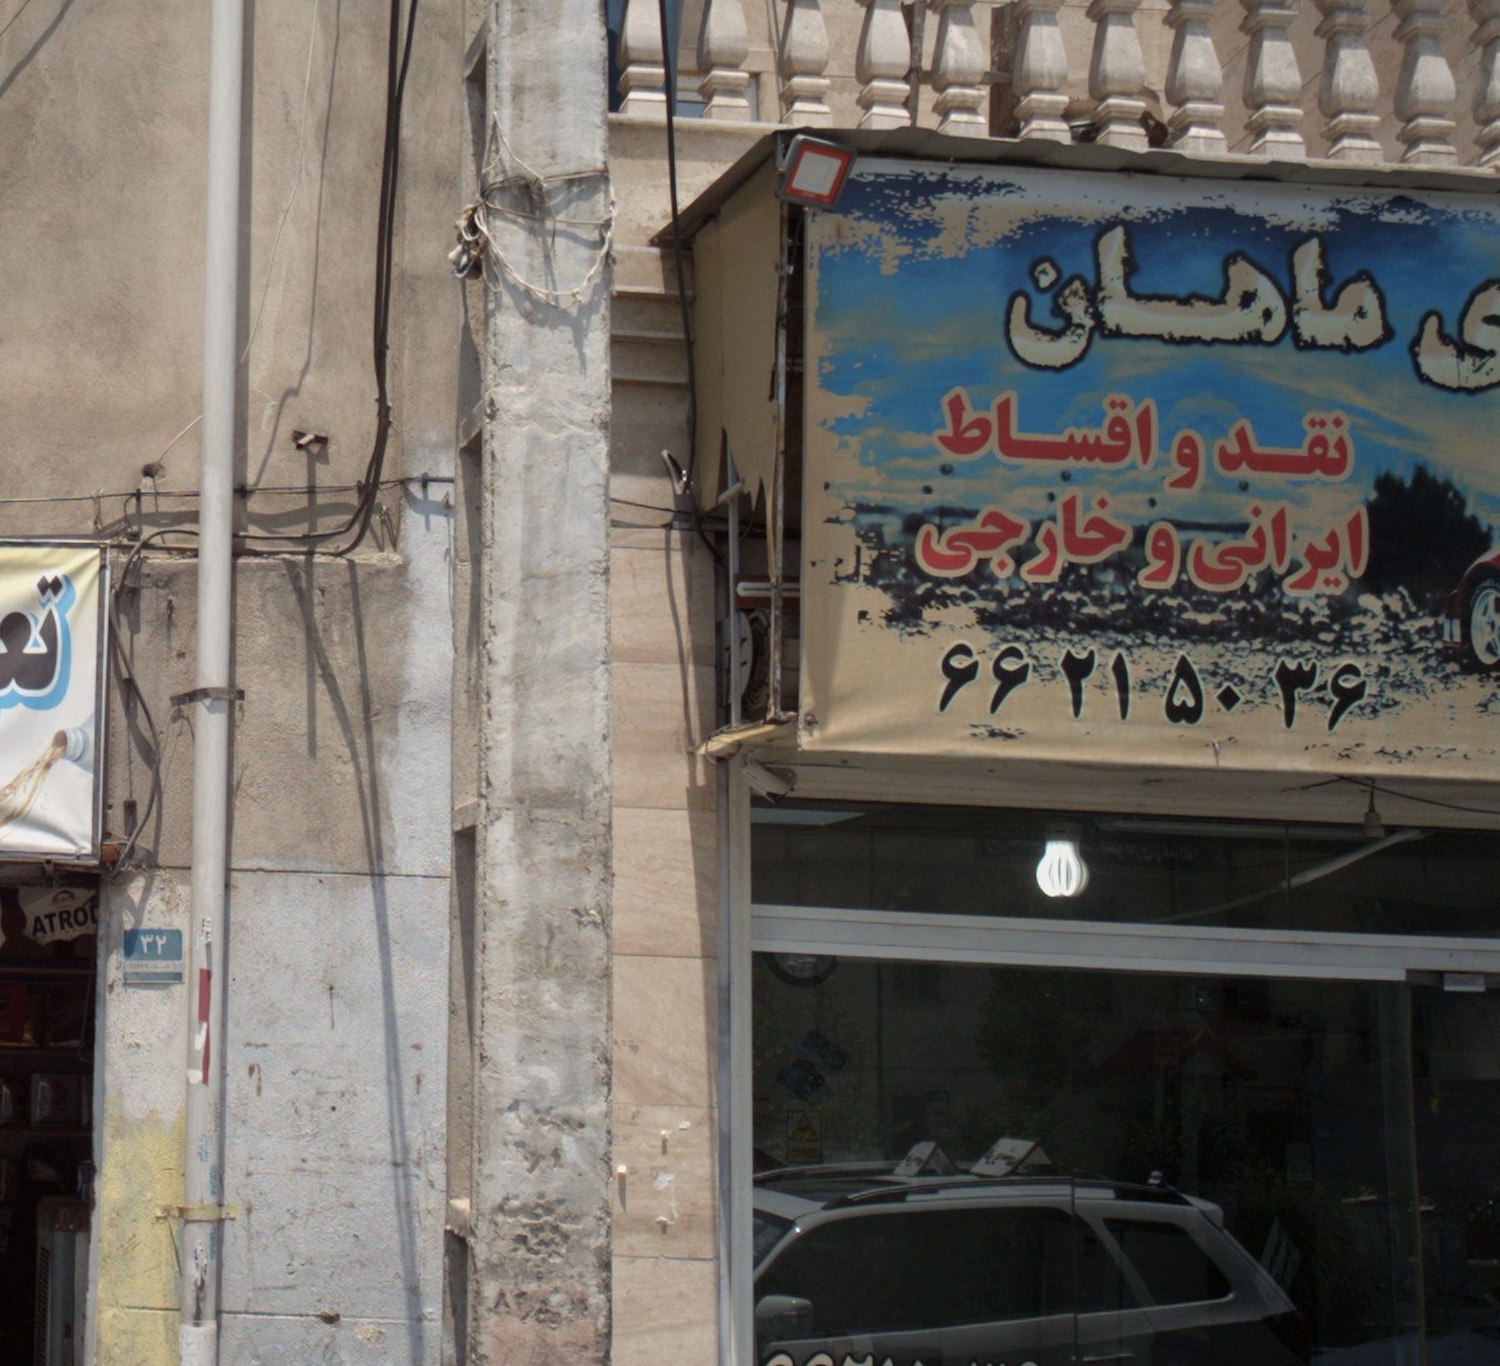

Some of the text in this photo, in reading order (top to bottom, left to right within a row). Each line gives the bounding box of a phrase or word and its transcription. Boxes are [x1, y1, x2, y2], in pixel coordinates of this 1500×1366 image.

[1006, 223, 1394, 373] ماهان
[936, 389, 1353, 489] نقد و اقساط
[918, 493, 1130, 583] خارجی
[1143, 517, 1181, 587] و
[1190, 504, 1368, 594] ایرانی
[139, 933, 167, 955] ۳۲
